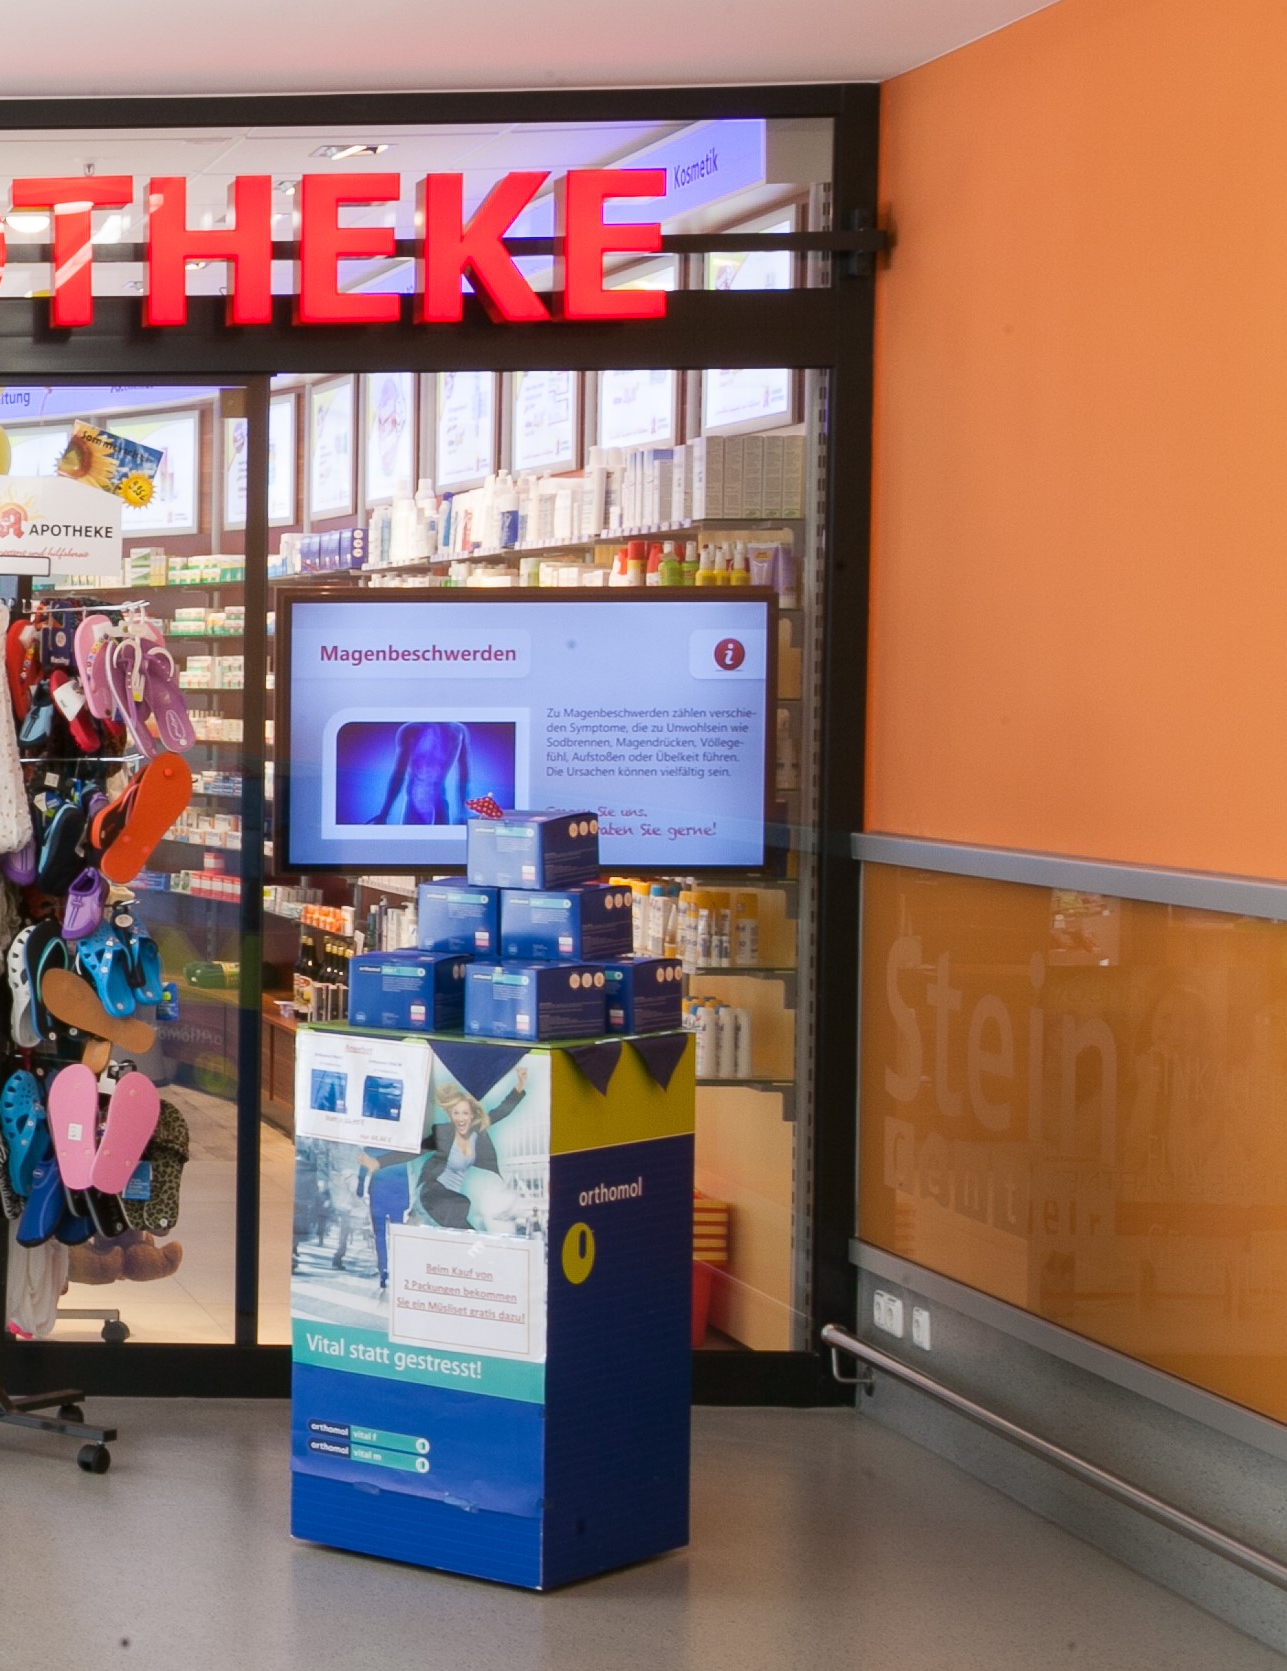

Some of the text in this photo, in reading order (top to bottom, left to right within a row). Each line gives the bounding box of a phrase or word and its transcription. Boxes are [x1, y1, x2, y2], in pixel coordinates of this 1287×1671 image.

[673, 147, 720, 190] Kosmetik
[29, 524, 113, 539] APOTHEKE
[320, 644, 517, 666] Magenbeschwerden
[546, 707, 757, 721] Zu Magenbeschwerden zählen verschie-
[546, 722, 749, 736] den Symptome, die zu Unwohlsein wie
[546, 737, 745, 750] Sodbrennen, Magendrücken, Völlege-
[546, 749, 740, 763] fühl, Aufstoßen oder Übelkeit führen.
[546, 766, 731, 780] Die Ursachen können vielfältig sein.
[597, 806, 617, 818] Sie
[620, 808, 648, 818] uns.
[639, 822, 662, 836] Sie
[667, 822, 717, 841] gerne!
[884, 934, 1118, 1168] Stein
[579, 1176, 643, 1206] orthomol
[426, 1263, 493, 1280] Beim Kauf von
[404, 1279, 517, 1302] 2 Packungen bekommen
[396, 1297, 525, 1324] Sie ein Müsliset gratis dazu!
[306, 1333, 483, 1380] Vital statt gestresst!
[310, 1421, 377, 1441] orthomol vital f
[310, 1440, 382, 1461] orthomol vital m
